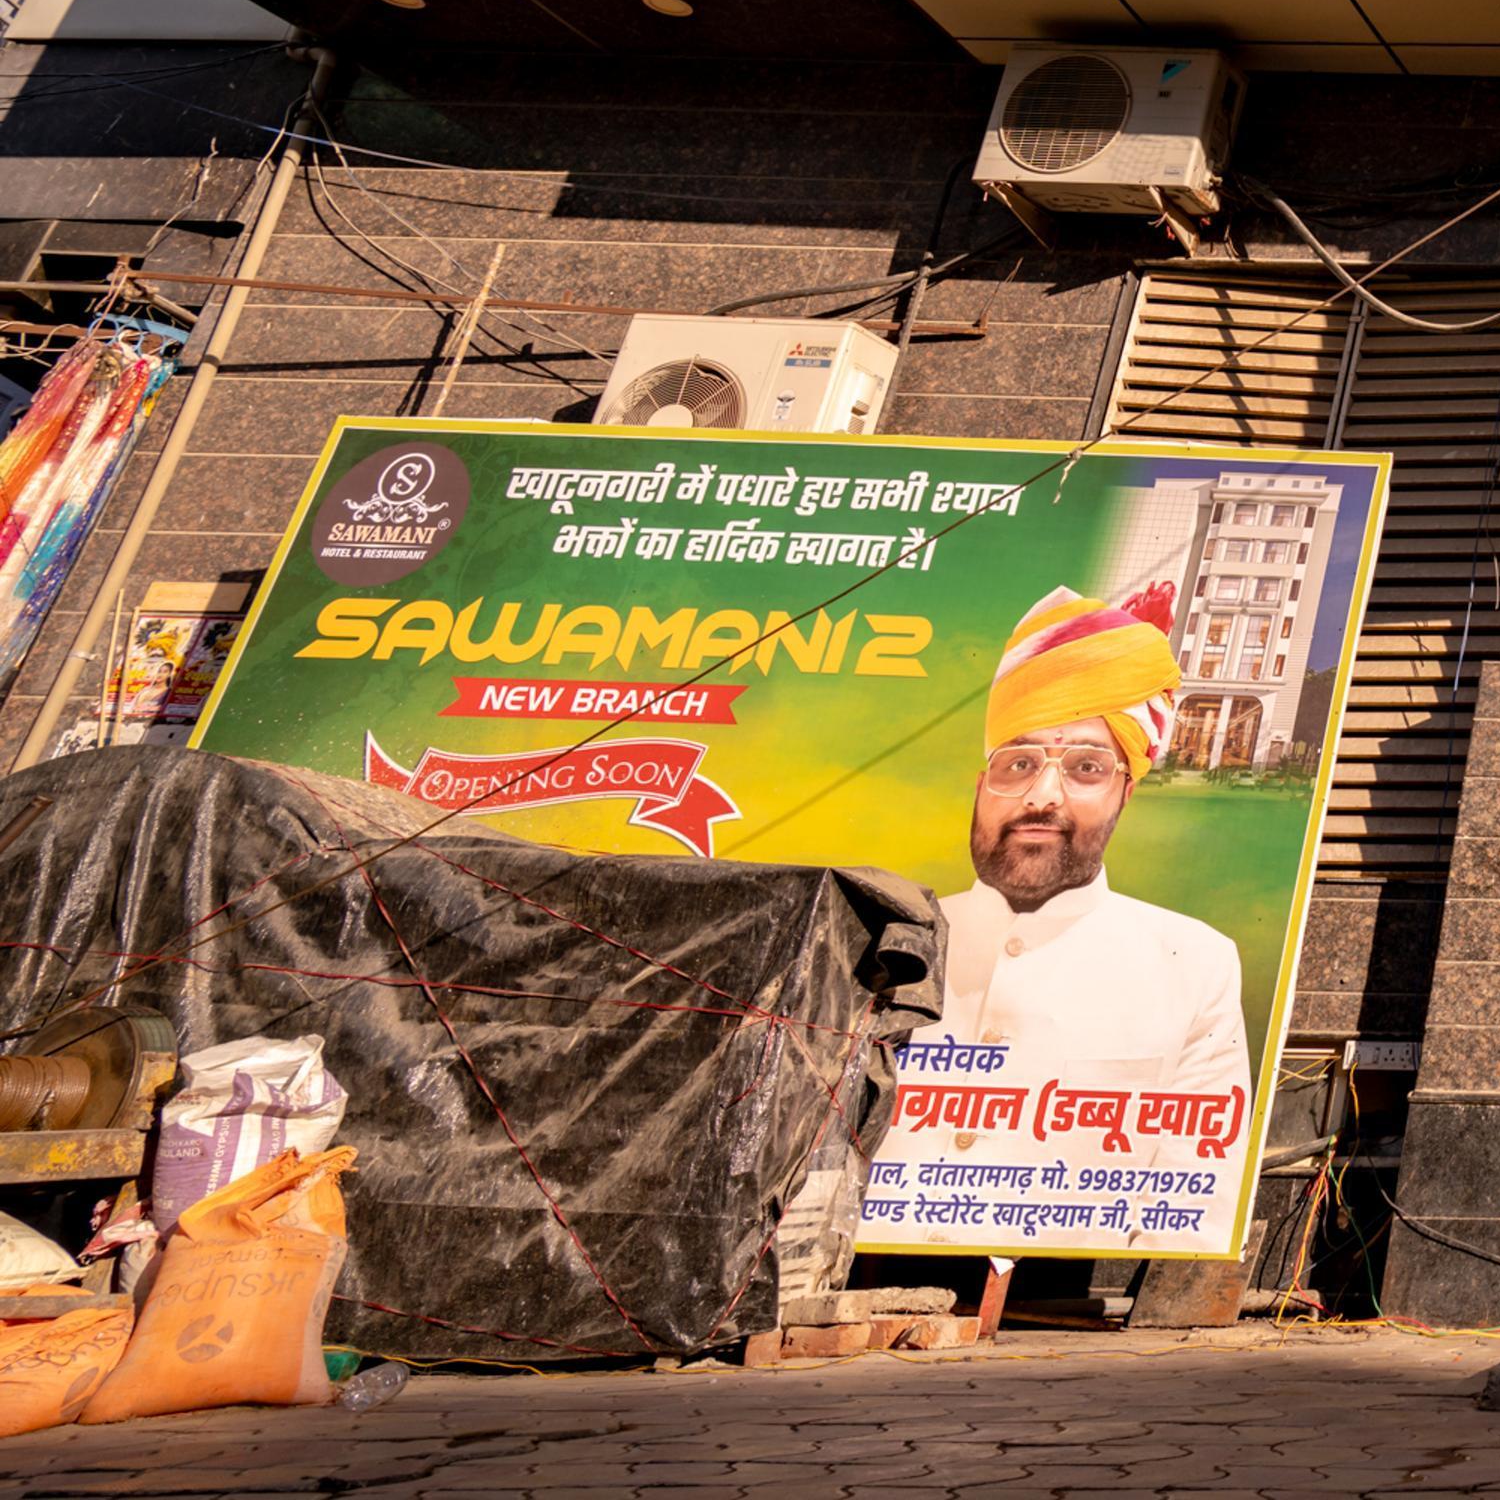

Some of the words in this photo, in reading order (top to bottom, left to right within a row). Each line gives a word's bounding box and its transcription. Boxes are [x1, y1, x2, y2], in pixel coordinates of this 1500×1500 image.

[389, 462, 423, 496] S
[505, 462, 676, 515] खाटूनगरी
[676, 463, 718, 505] में
[714, 466, 800, 508] पधारे
[794, 476, 851, 516] हुए
[850, 470, 930, 513] सभी
[320, 546, 351, 559] HOTEL
[352, 547, 362, 559] &
[362, 548, 428, 561] RESTAURANT
[326, 522, 439, 546] SAWAMANI
[552, 517, 639, 559] भक्तों
[634, 527, 685, 561] का
[683, 517, 786, 564] हार्दिक
[784, 532, 897, 569] स्वागत
[293, 596, 858, 677] SAWAMANI
[855, 613, 934, 678] 2
[479, 684, 564, 713] NEW
[569, 687, 709, 718] BRANCH
[419, 764, 577, 803] OPENING
[583, 753, 685, 791] SOON
[1040, 1159, 1070, 1191] मो.
[1077, 1168, 1217, 1195] 9983719762
[913, 1192, 989, 1226] रेस्टोरेंट
[992, 1202, 1096, 1237] खाटूश्याम
[1098, 1198, 1133, 1234] जी,
[1140, 1199, 1206, 1232] सीकर
